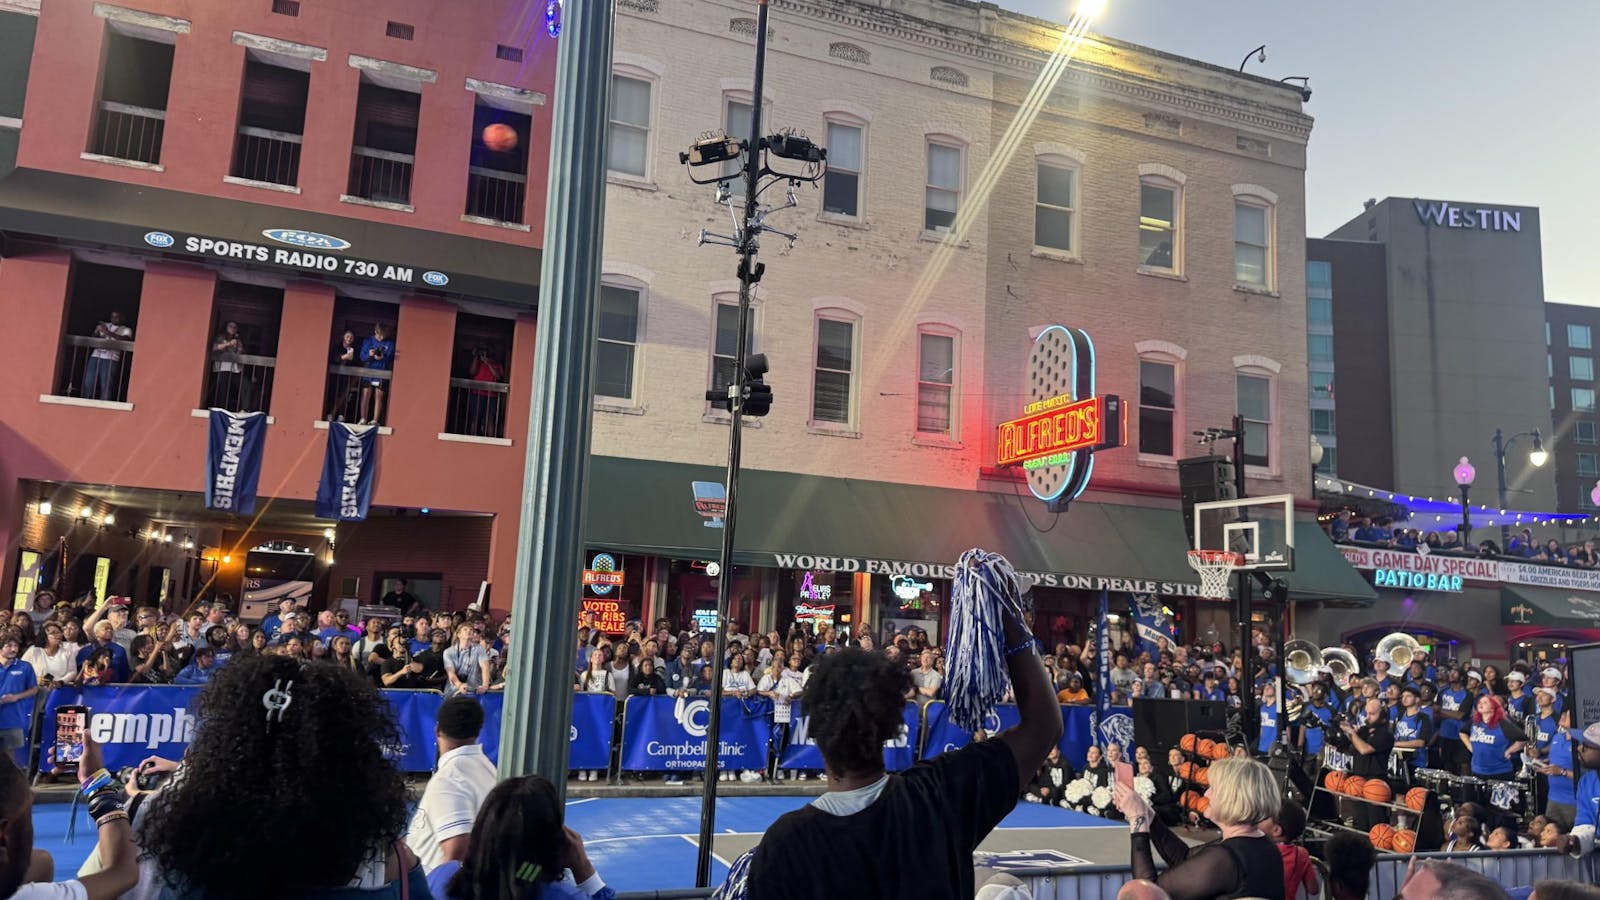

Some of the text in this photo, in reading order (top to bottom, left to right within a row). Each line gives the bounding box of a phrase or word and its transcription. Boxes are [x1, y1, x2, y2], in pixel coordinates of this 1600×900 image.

[1413, 199, 1520, 232] WESTIN
[185, 237, 269, 261] SPORTS
[275, 249, 338, 271] RADIO
[344, 259, 379, 277] 730
[383, 266, 413, 282] AM
[1000, 406, 1096, 461] ALFRED'S
[212, 417, 247, 509] MEMPHIS
[775, 554, 957, 579] WORLD FAMOUS
[1372, 551, 1411, 570] GAME
[1414, 555, 1440, 573] DAY
[1442, 557, 1498, 579] SPECIAL!
[1518, 564, 1537, 575] $4.00
[1538, 566, 1569, 578] AMERICAN
[1571, 570, 1588, 580] BEER
[584, 572, 622, 583] ALFRED'S
[1062, 575, 1092, 589] ON
[1097, 577, 1157, 594] BEALE
[1375, 569, 1463, 591] PATIO BAR
[1518, 575, 1529, 583] ALL
[1530, 576, 1557, 586] GRIZZLIES
[1558, 579, 1570, 588] AND
[800, 590, 831, 600] PRESLEY
[583, 601, 619, 612] VOTED
[594, 621, 625, 632] BEALE
[602, 612, 626, 622] RIBS
[88, 707, 196, 749] emph
[647, 741, 708, 760] Campbell
